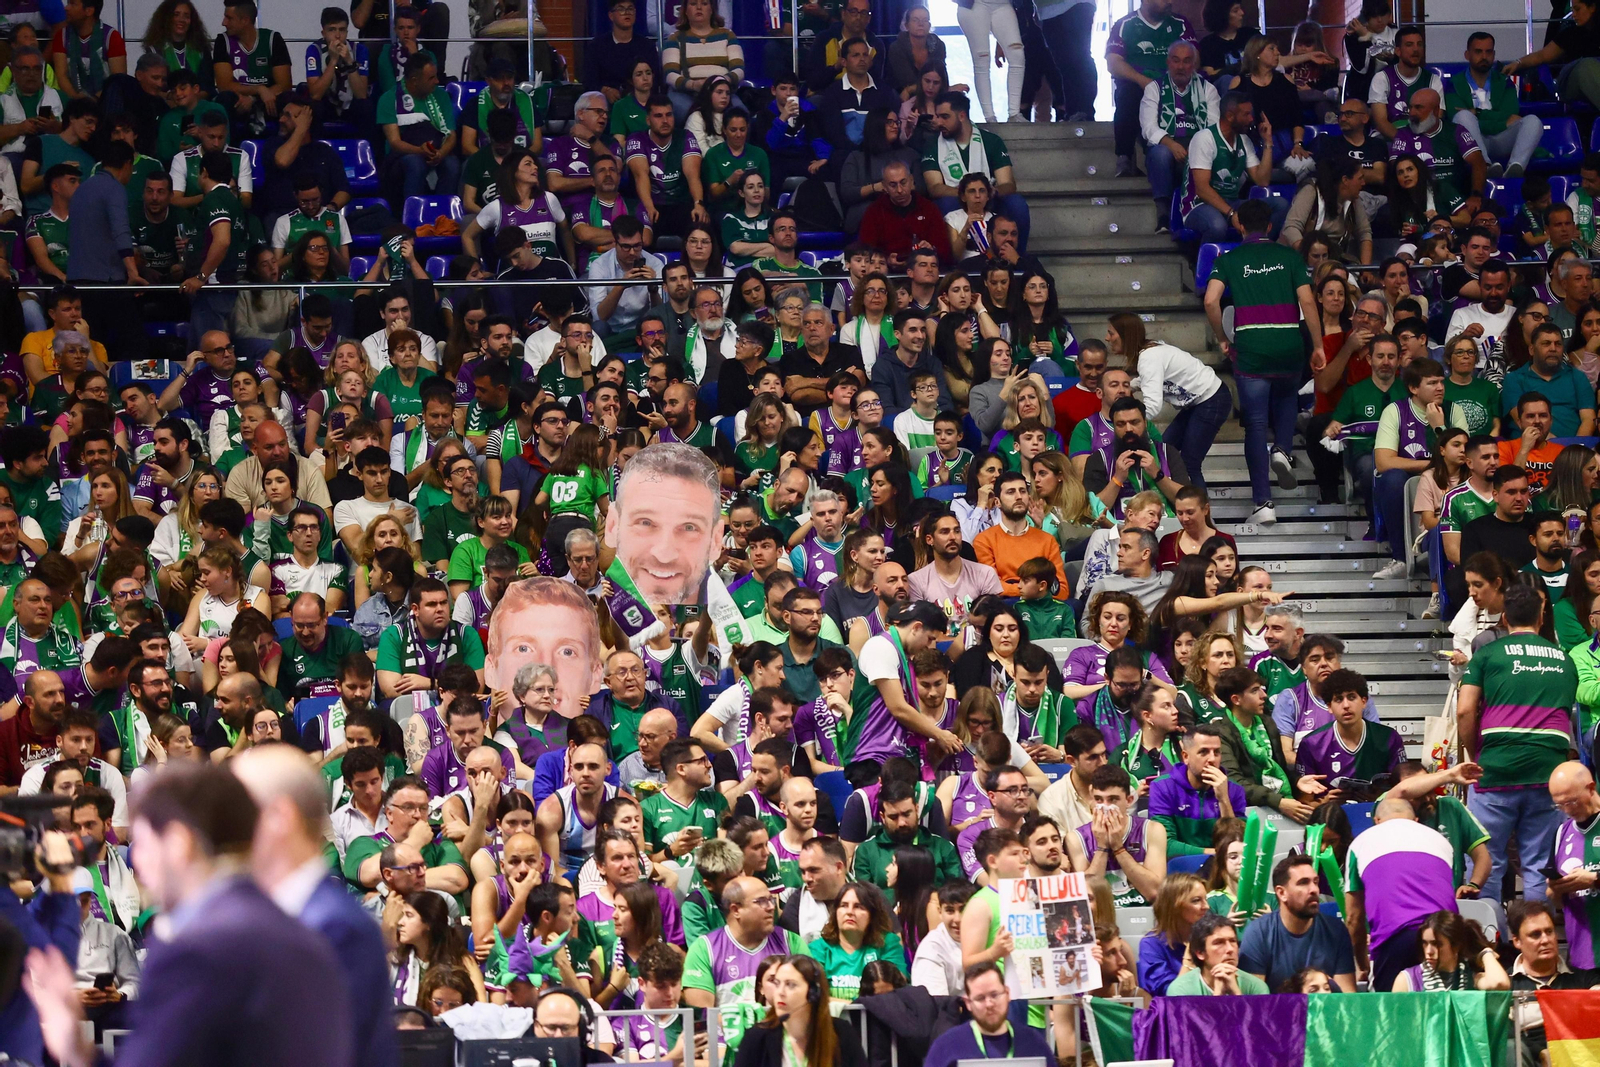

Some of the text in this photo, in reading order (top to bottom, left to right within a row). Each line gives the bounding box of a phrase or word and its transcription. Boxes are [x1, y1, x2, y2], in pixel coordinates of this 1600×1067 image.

[527, 230, 552, 238] Unicaja
[552, 481, 578, 503] 03
[1504, 644, 1524, 655] LOS
[660, 688, 686, 696] Unicaja
[1038, 873, 1083, 901] LLULL
